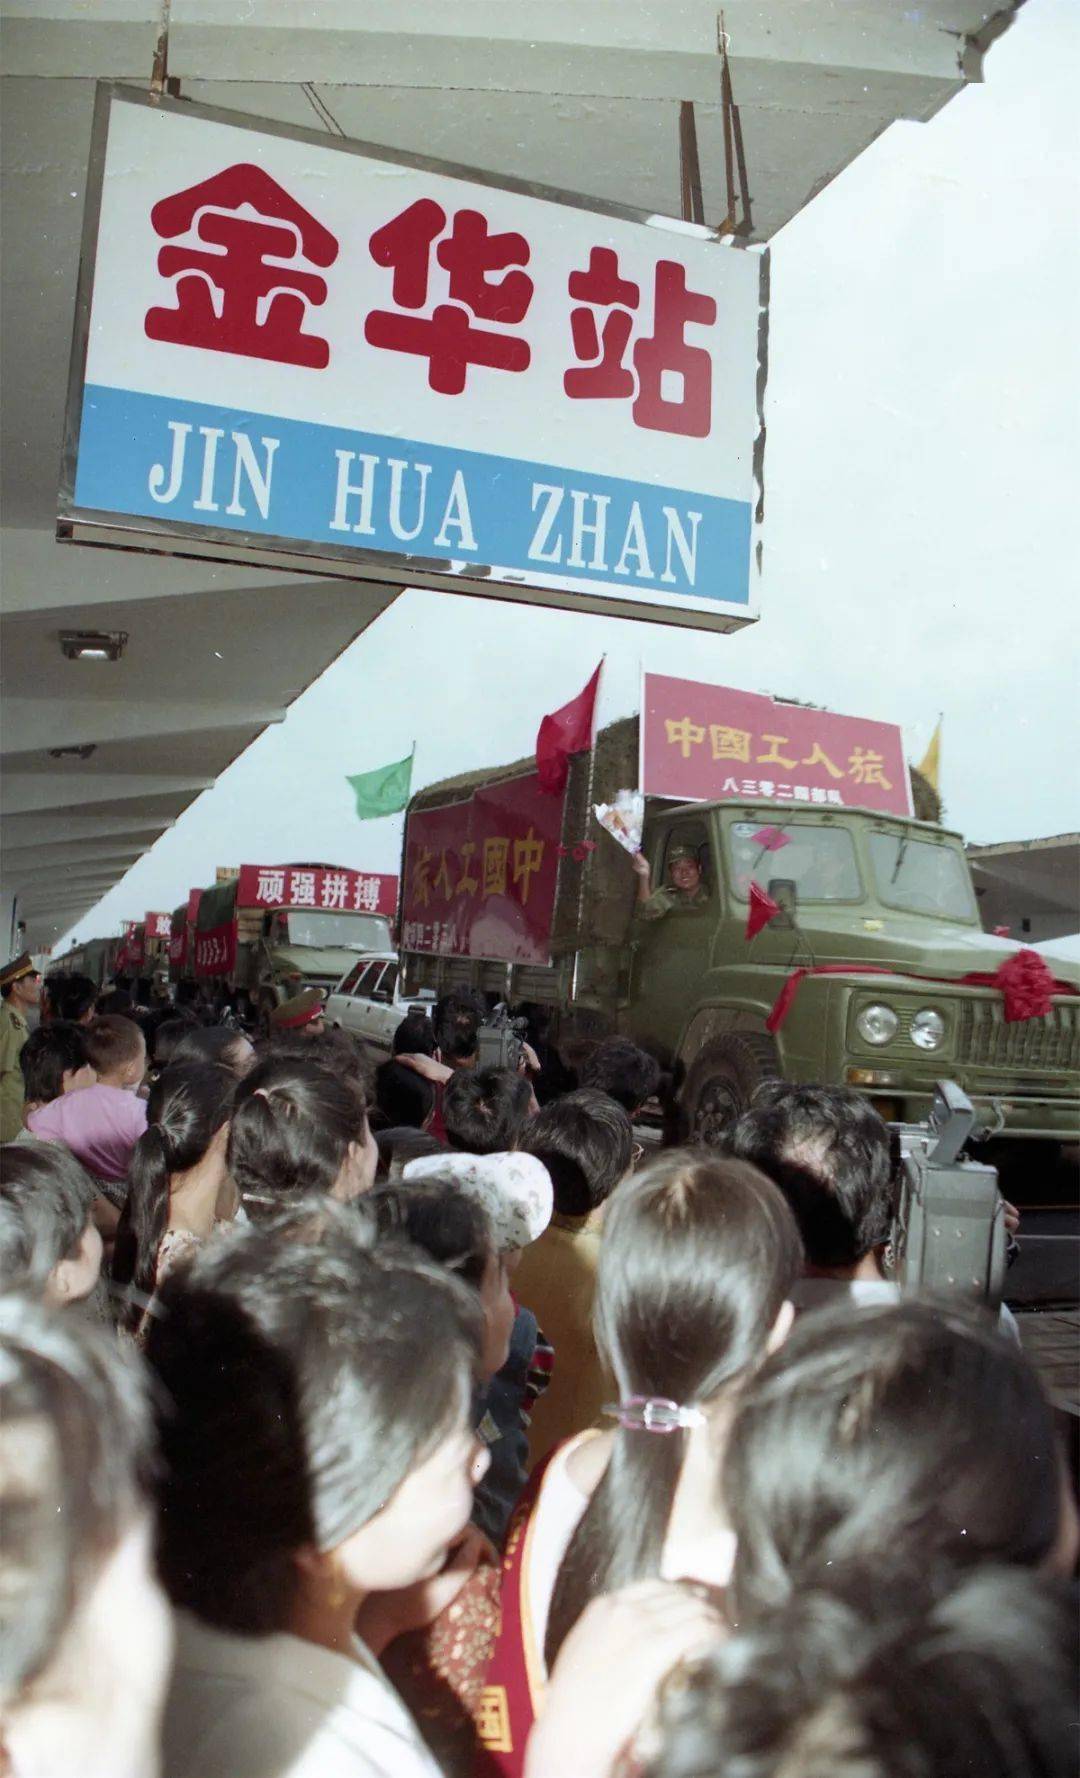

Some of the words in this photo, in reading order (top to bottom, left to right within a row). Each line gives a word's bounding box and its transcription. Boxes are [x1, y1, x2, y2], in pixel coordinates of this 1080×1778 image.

[143, 162, 718, 439] 金华站
[147, 420, 281, 521] JIN
[328, 449, 479, 552] HUA
[526, 482, 704, 587] ZHAN
[256, 870, 381, 911] 顽强拼搏
